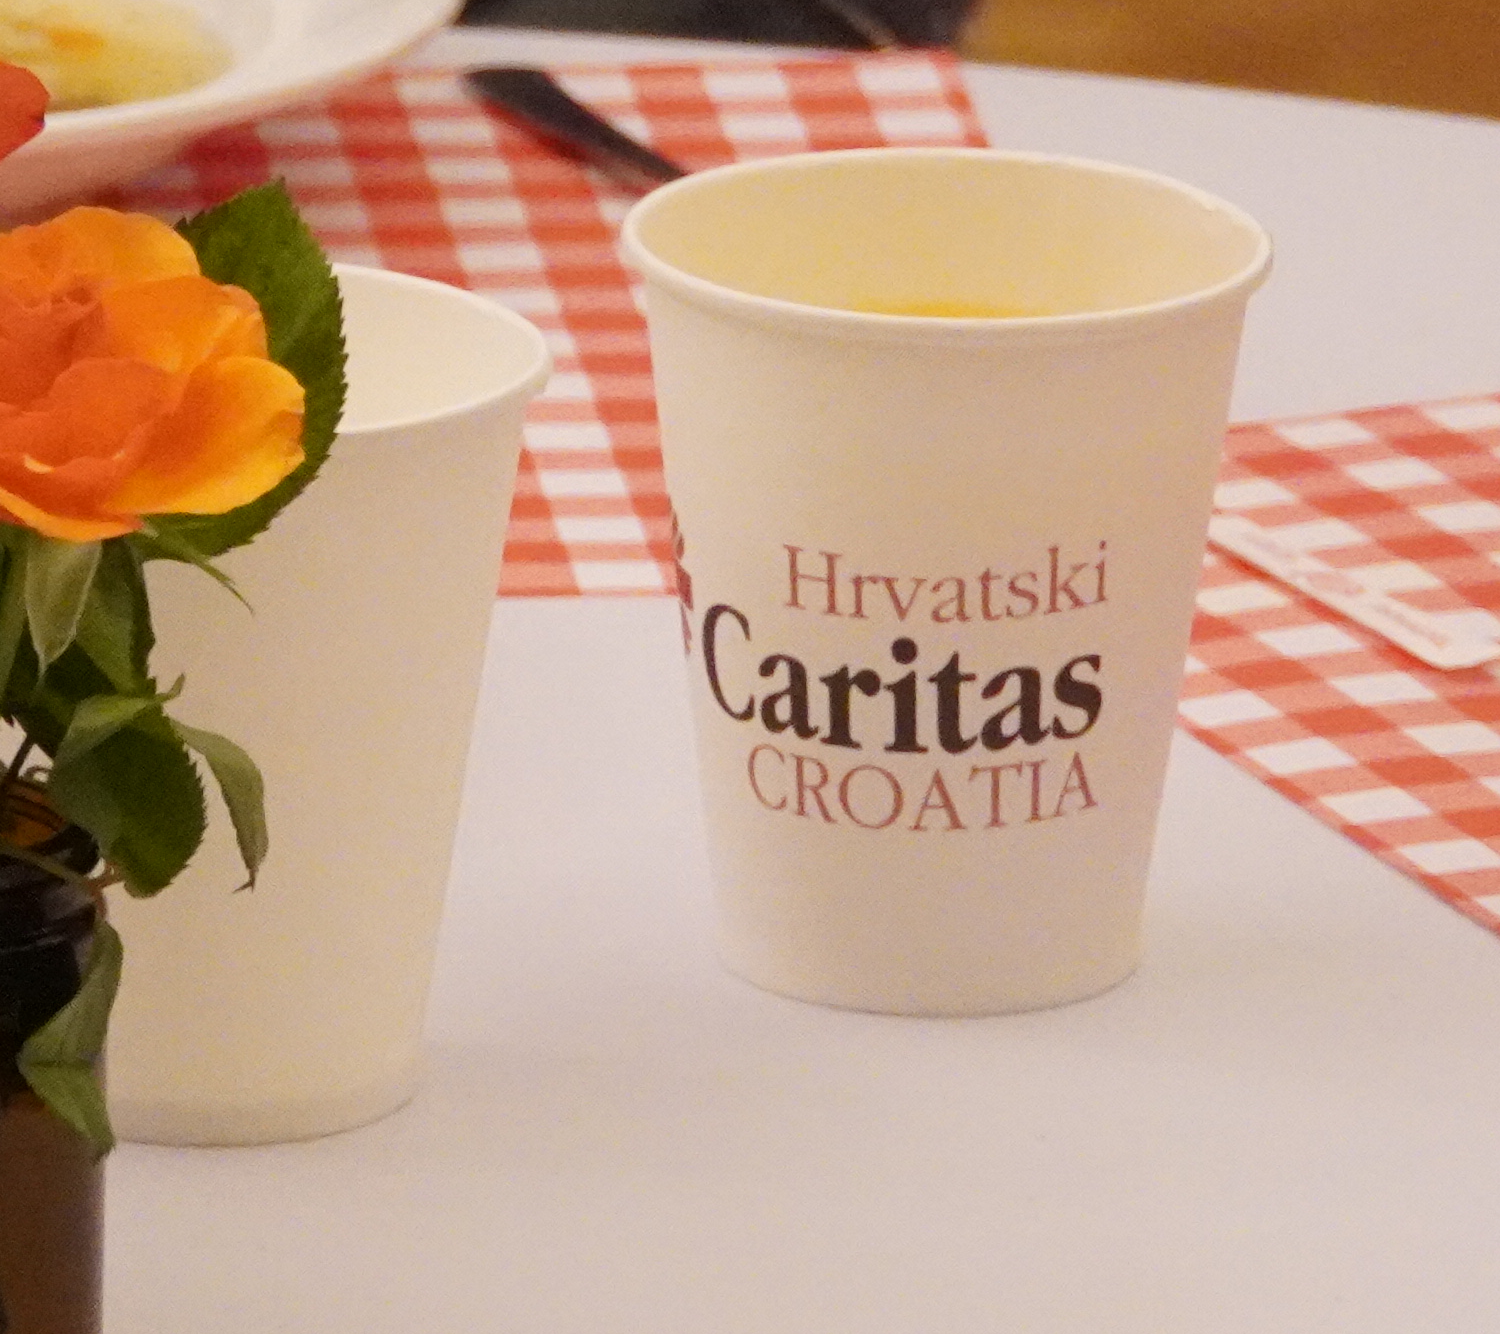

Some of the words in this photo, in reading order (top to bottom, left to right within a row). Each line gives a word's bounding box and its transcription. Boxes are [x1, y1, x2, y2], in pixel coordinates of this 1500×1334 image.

[783, 539, 1110, 624] Hrvatski
[702, 603, 1103, 755] Caritas
[747, 743, 1100, 832] CROATIA
